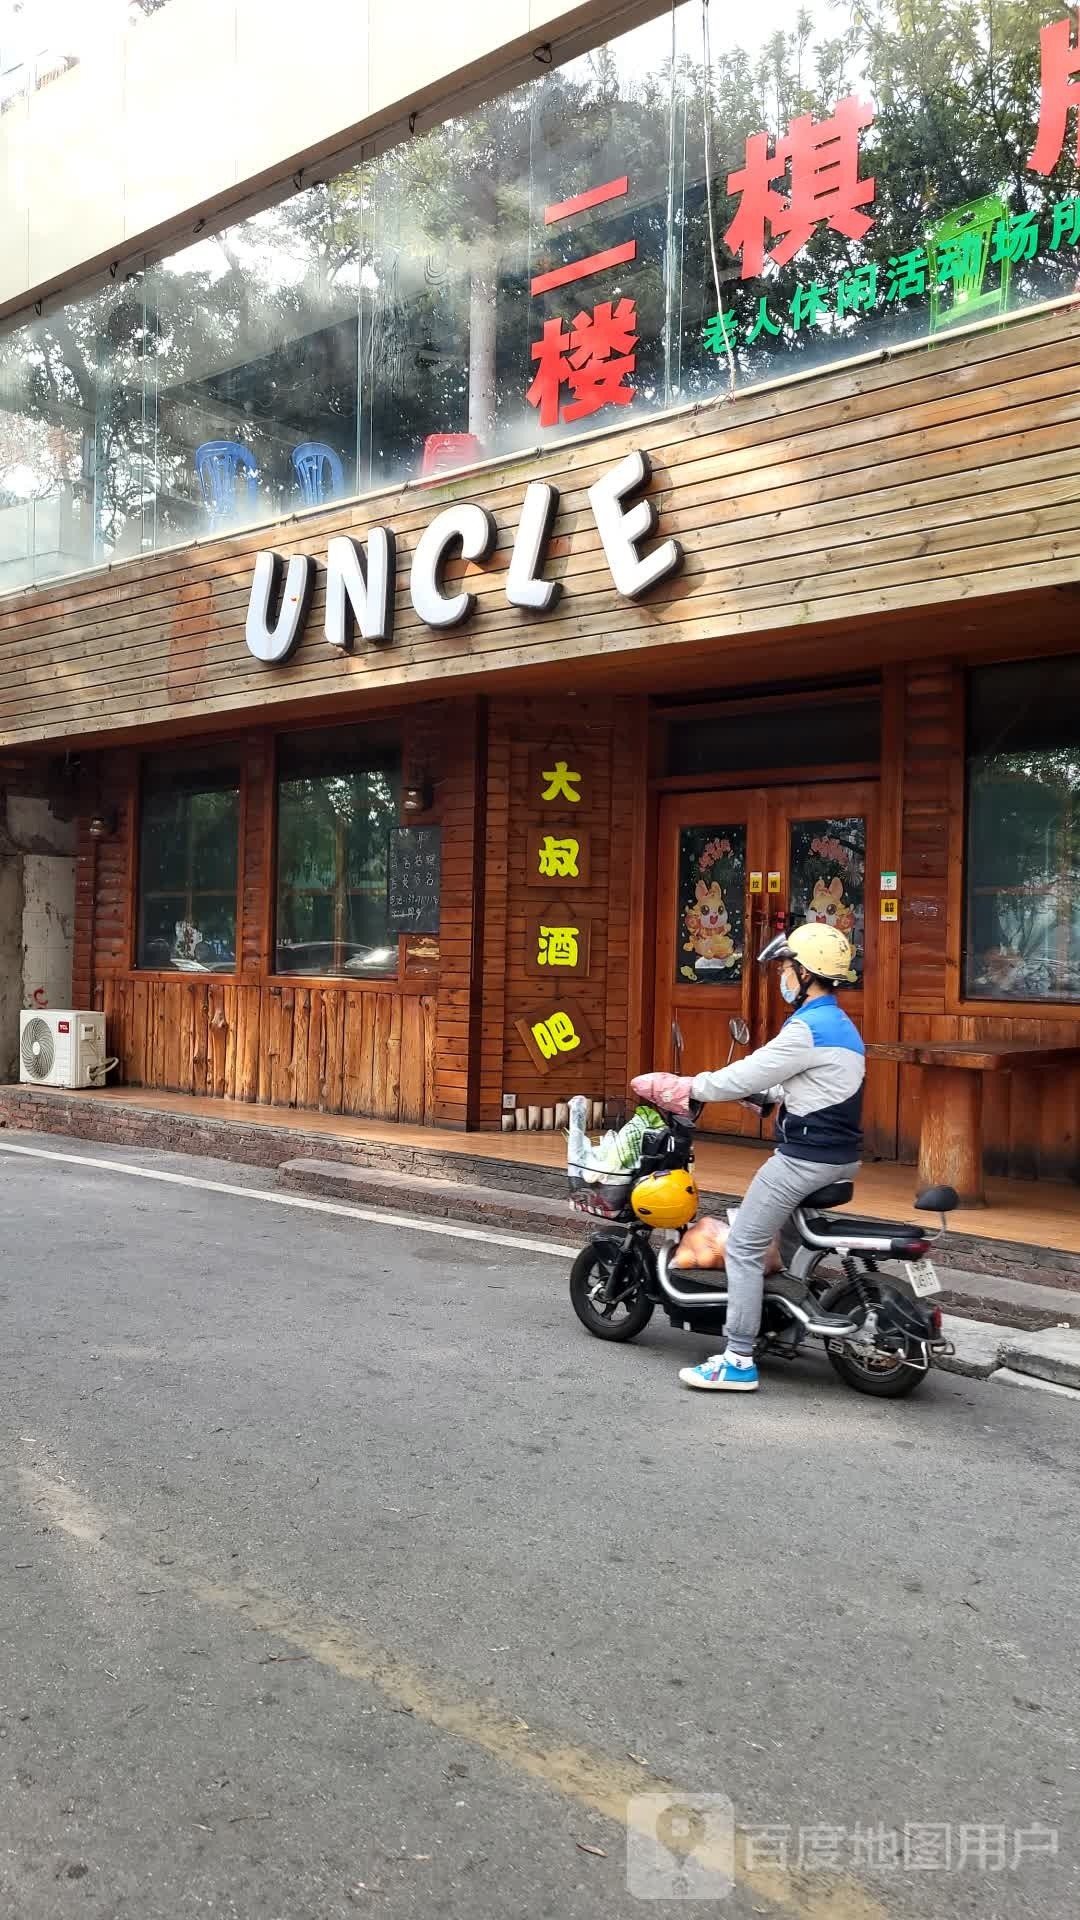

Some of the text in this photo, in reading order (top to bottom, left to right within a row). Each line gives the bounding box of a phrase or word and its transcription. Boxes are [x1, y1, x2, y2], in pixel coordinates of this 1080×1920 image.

[527, 175, 637, 427] 二楼
[245, 449, 685, 664] UNCLE
[529, 760, 581, 1060] 大叔酒吧
